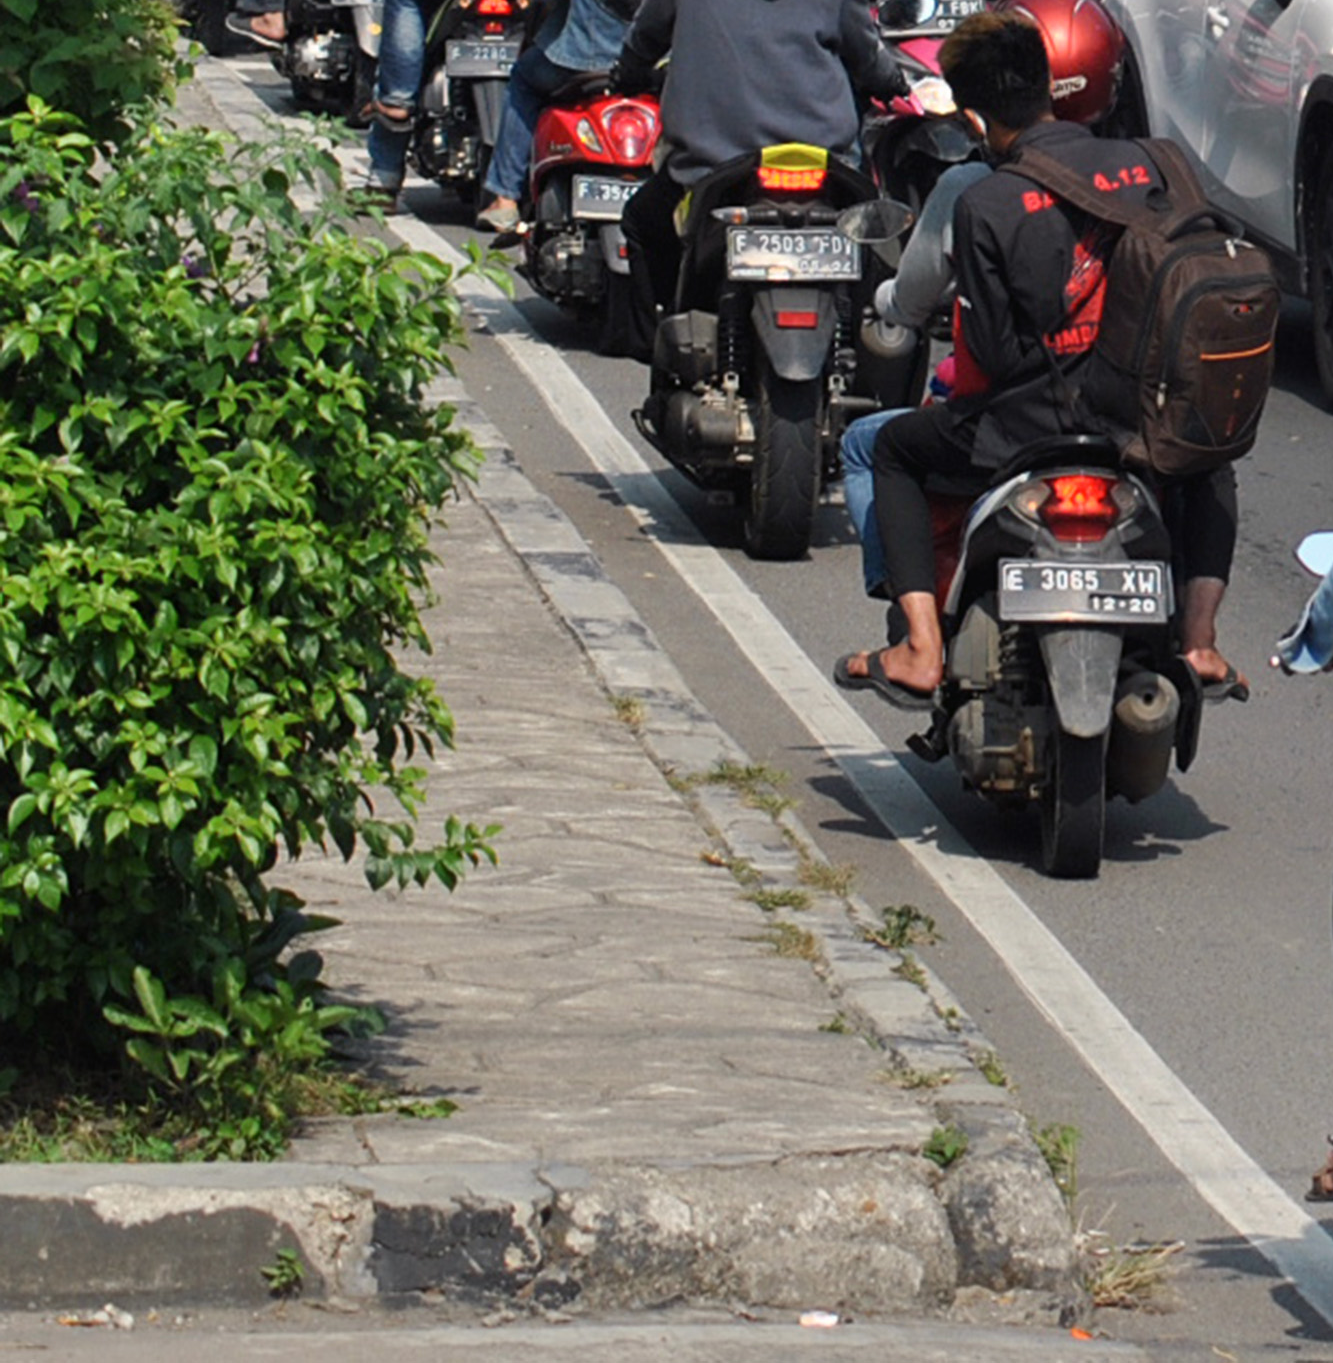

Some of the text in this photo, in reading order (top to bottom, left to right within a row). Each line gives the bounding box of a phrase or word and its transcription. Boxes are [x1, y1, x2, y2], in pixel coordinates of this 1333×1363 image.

[579, 182, 589, 198] F
[736, 235, 746, 253] F
[760, 235, 805, 253] 2503
[1006, 569, 1155, 593] E 3065 XW
